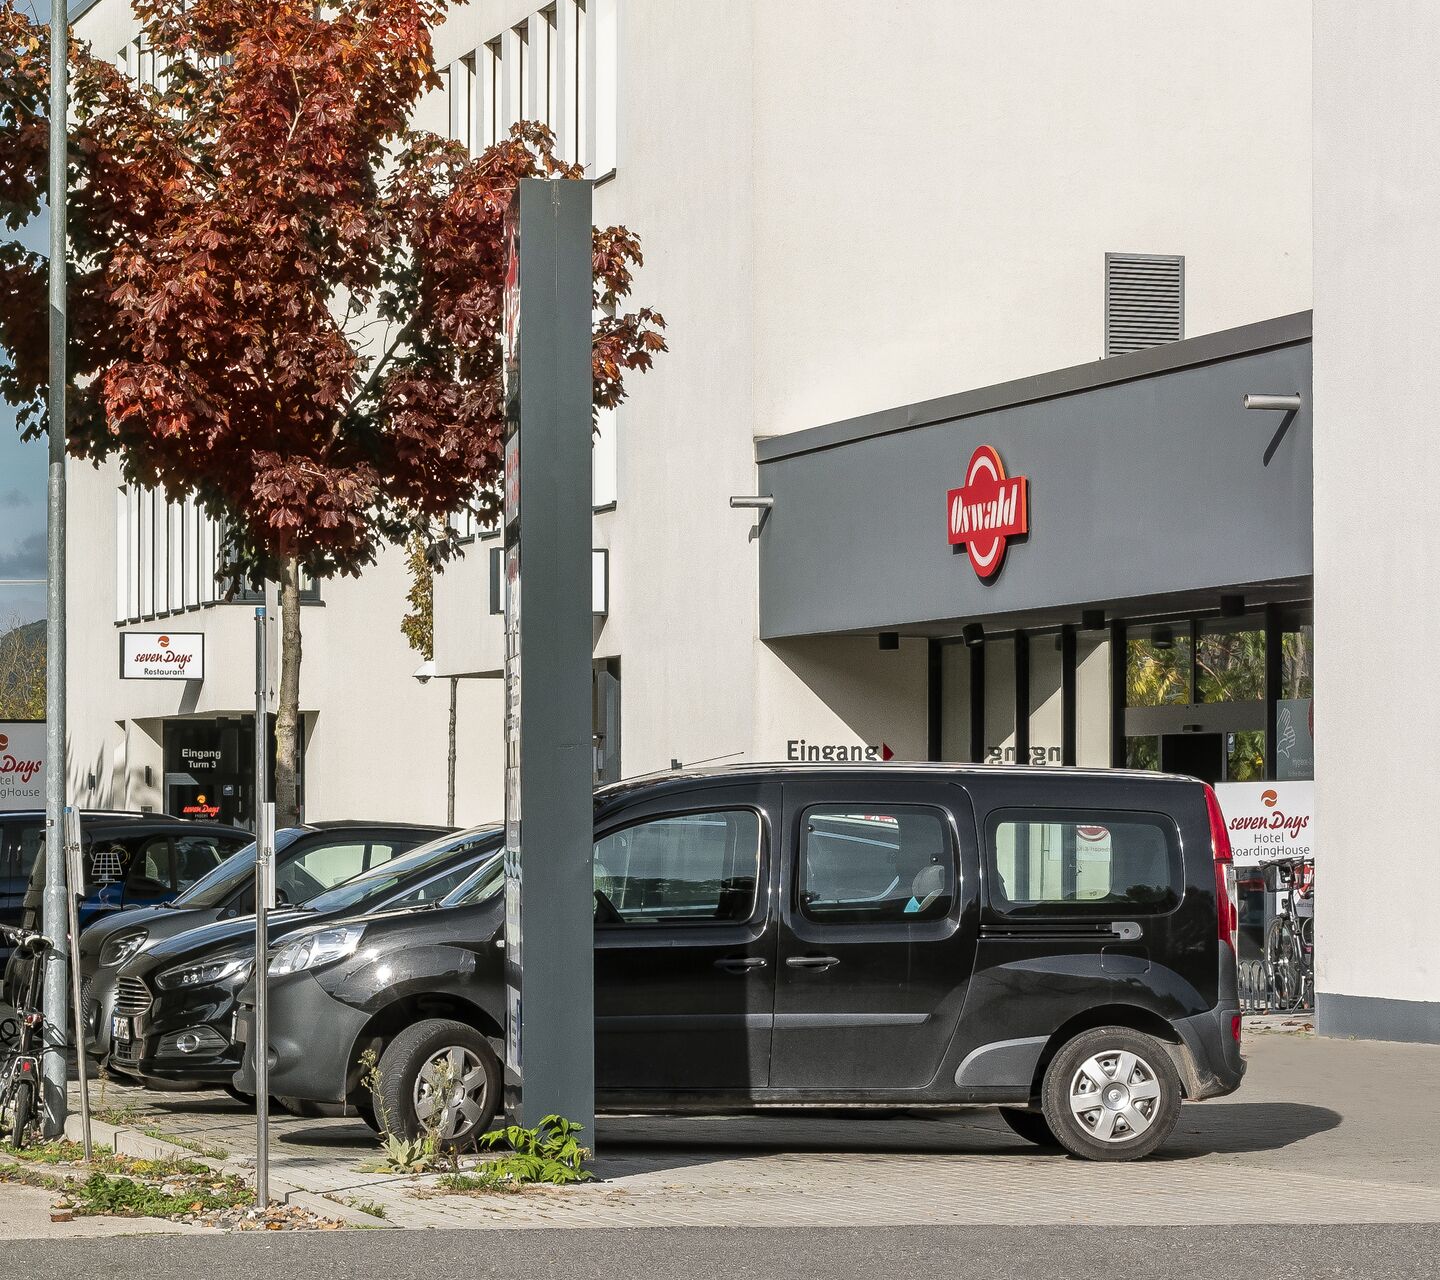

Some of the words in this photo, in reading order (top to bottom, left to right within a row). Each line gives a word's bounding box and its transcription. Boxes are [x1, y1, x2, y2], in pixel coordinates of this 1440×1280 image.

[951, 484, 1018, 534] Oswald
[143, 667, 186, 676] Restaurant
[181, 748, 222, 760] Eingang
[787, 740, 879, 761] Eingang
[188, 760, 209, 769] Turm
[211, 760, 217, 769] 3
[1254, 833, 1285, 844] Hotel
